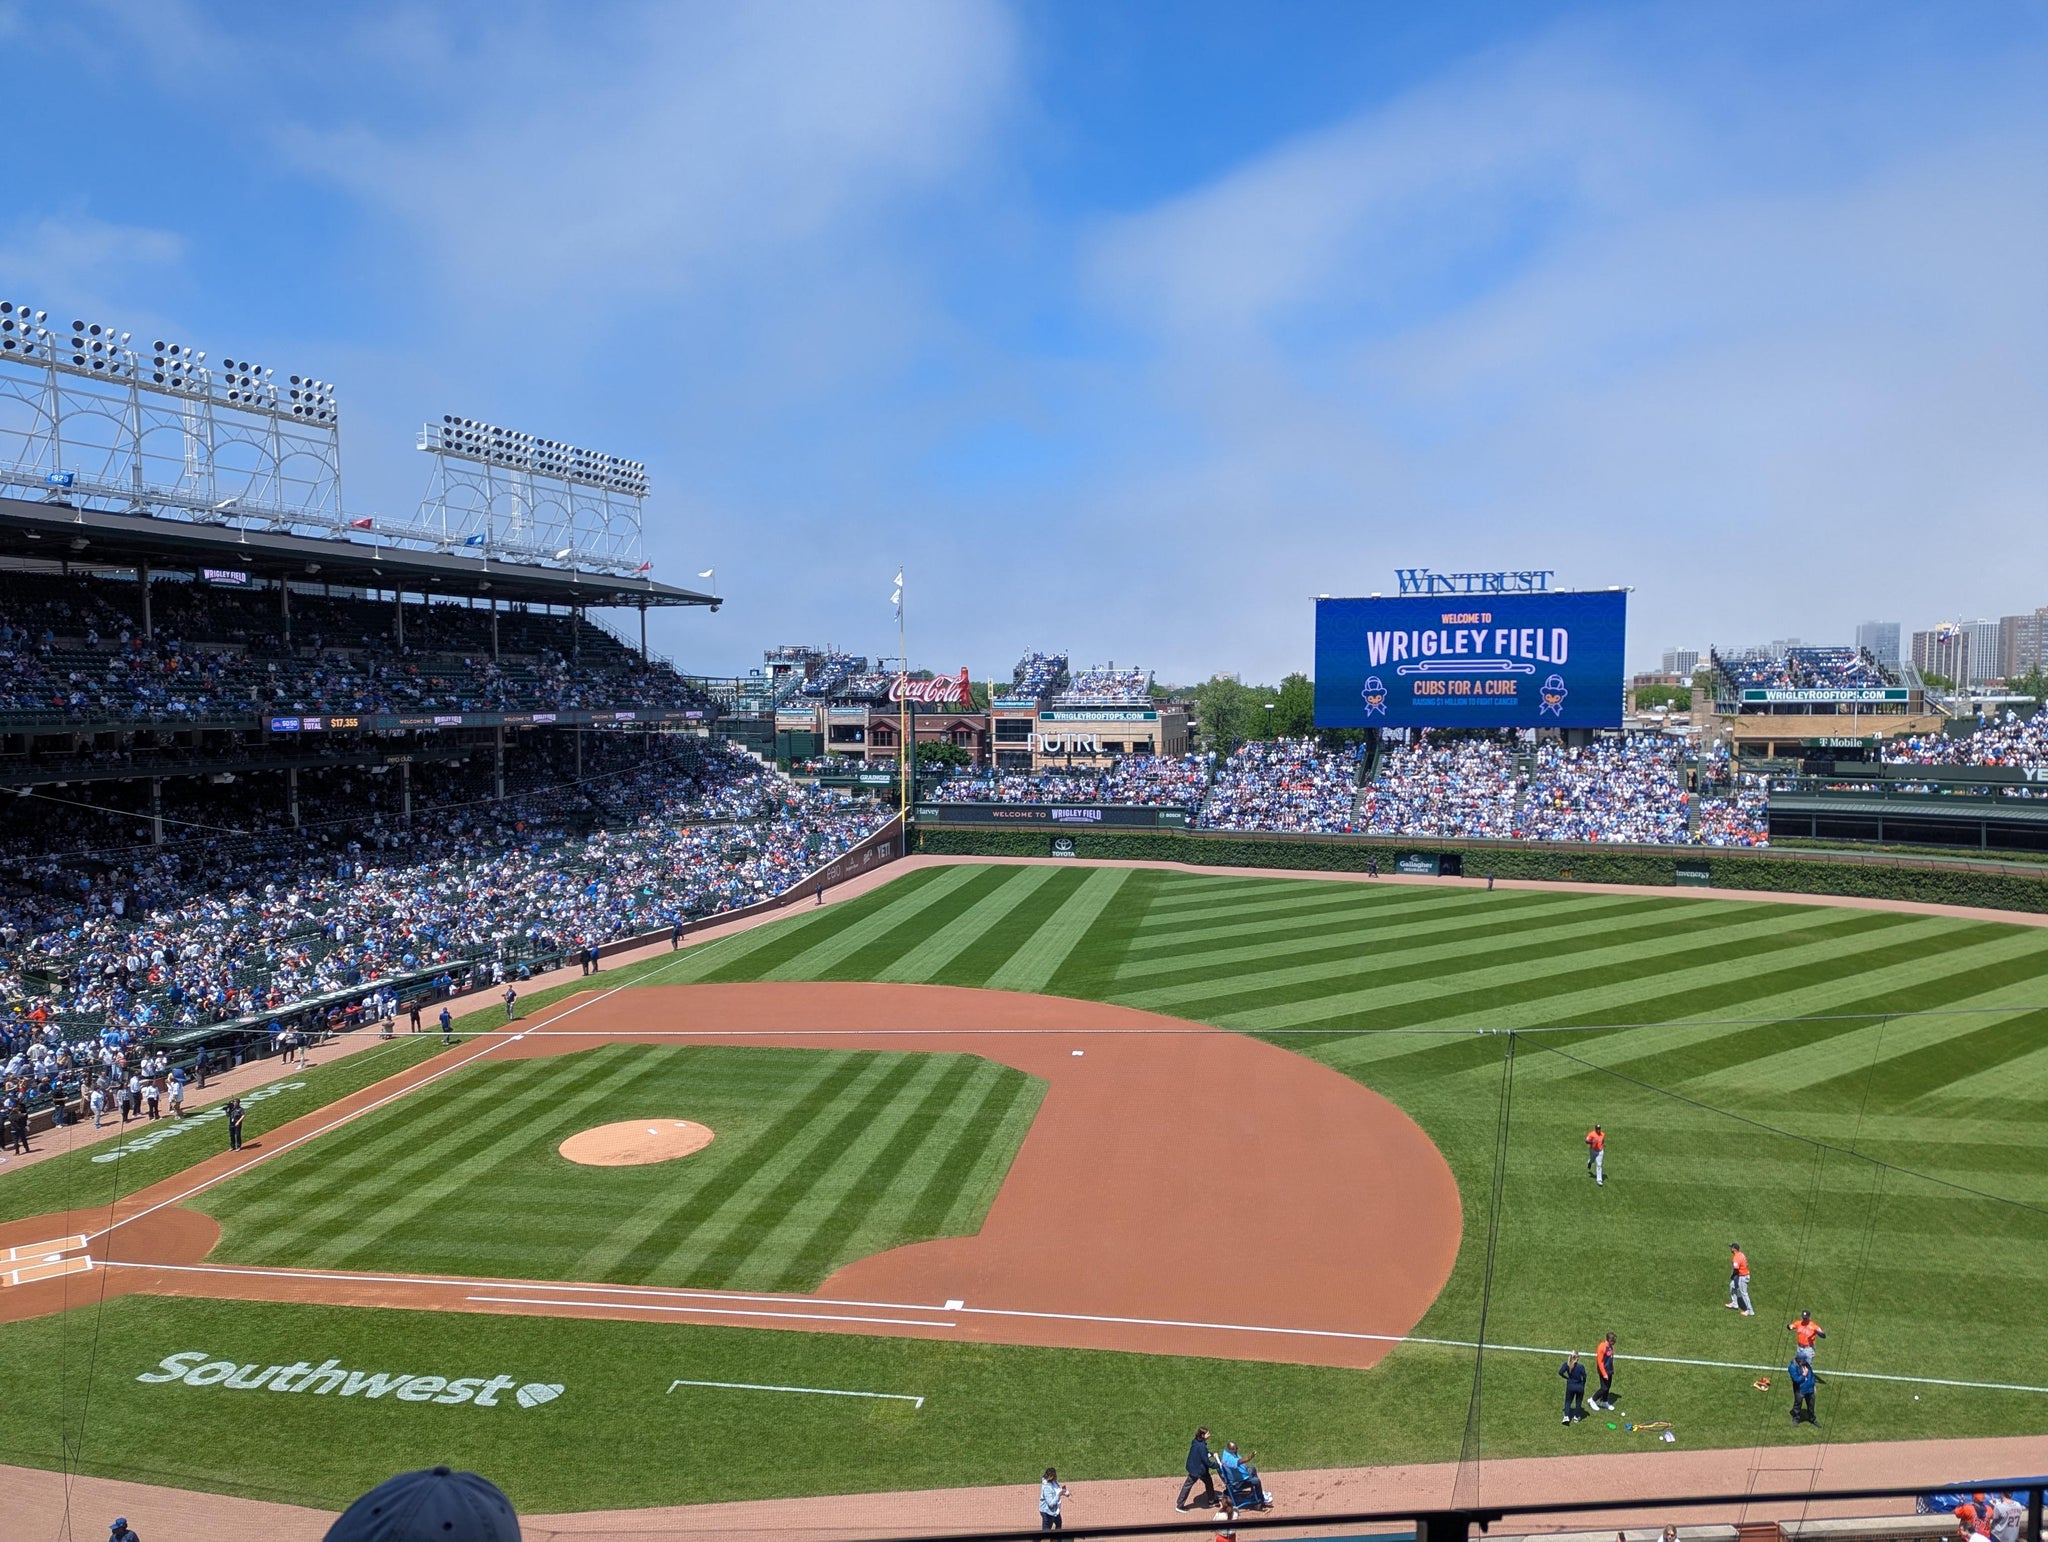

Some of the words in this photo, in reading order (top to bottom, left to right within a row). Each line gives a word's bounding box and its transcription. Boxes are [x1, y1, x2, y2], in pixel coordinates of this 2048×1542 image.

[204, 569, 230, 579] WRIGLEY
[230, 571, 246, 583] FIELD
[1394, 569, 1555, 594] WINTRUST
[1441, 613, 1479, 624] WELCOME
[1481, 613, 1492, 623] TO
[1367, 629, 1488, 667] WRIGLEY
[1495, 628, 1568, 665] FIELD
[889, 672, 963, 702] Coca-Cola
[1414, 680, 1445, 695] CUBS
[1448, 680, 1471, 695] FOR
[1473, 680, 1483, 695] A
[1485, 680, 1517, 695] CURE
[1766, 690, 1886, 700] WRIGLEYROOFTOPS.COM
[1053, 712, 1145, 720] WRIGLEYROOFTOPS.COM
[304, 722, 322, 730] TOTAL
[330, 718, 359, 728] $17,355
[1830, 738, 1863, 747] Mobile
[917, 807, 940, 816] Harvey
[1052, 809, 1082, 819] WRIGLEY
[1083, 809, 1102, 820] FIELD
[877, 842, 891, 859] YETI
[1399, 860, 1433, 869] Gallagher
[136, 1351, 515, 1407] Southwest
[2007, 1516, 2021, 1528] 27
